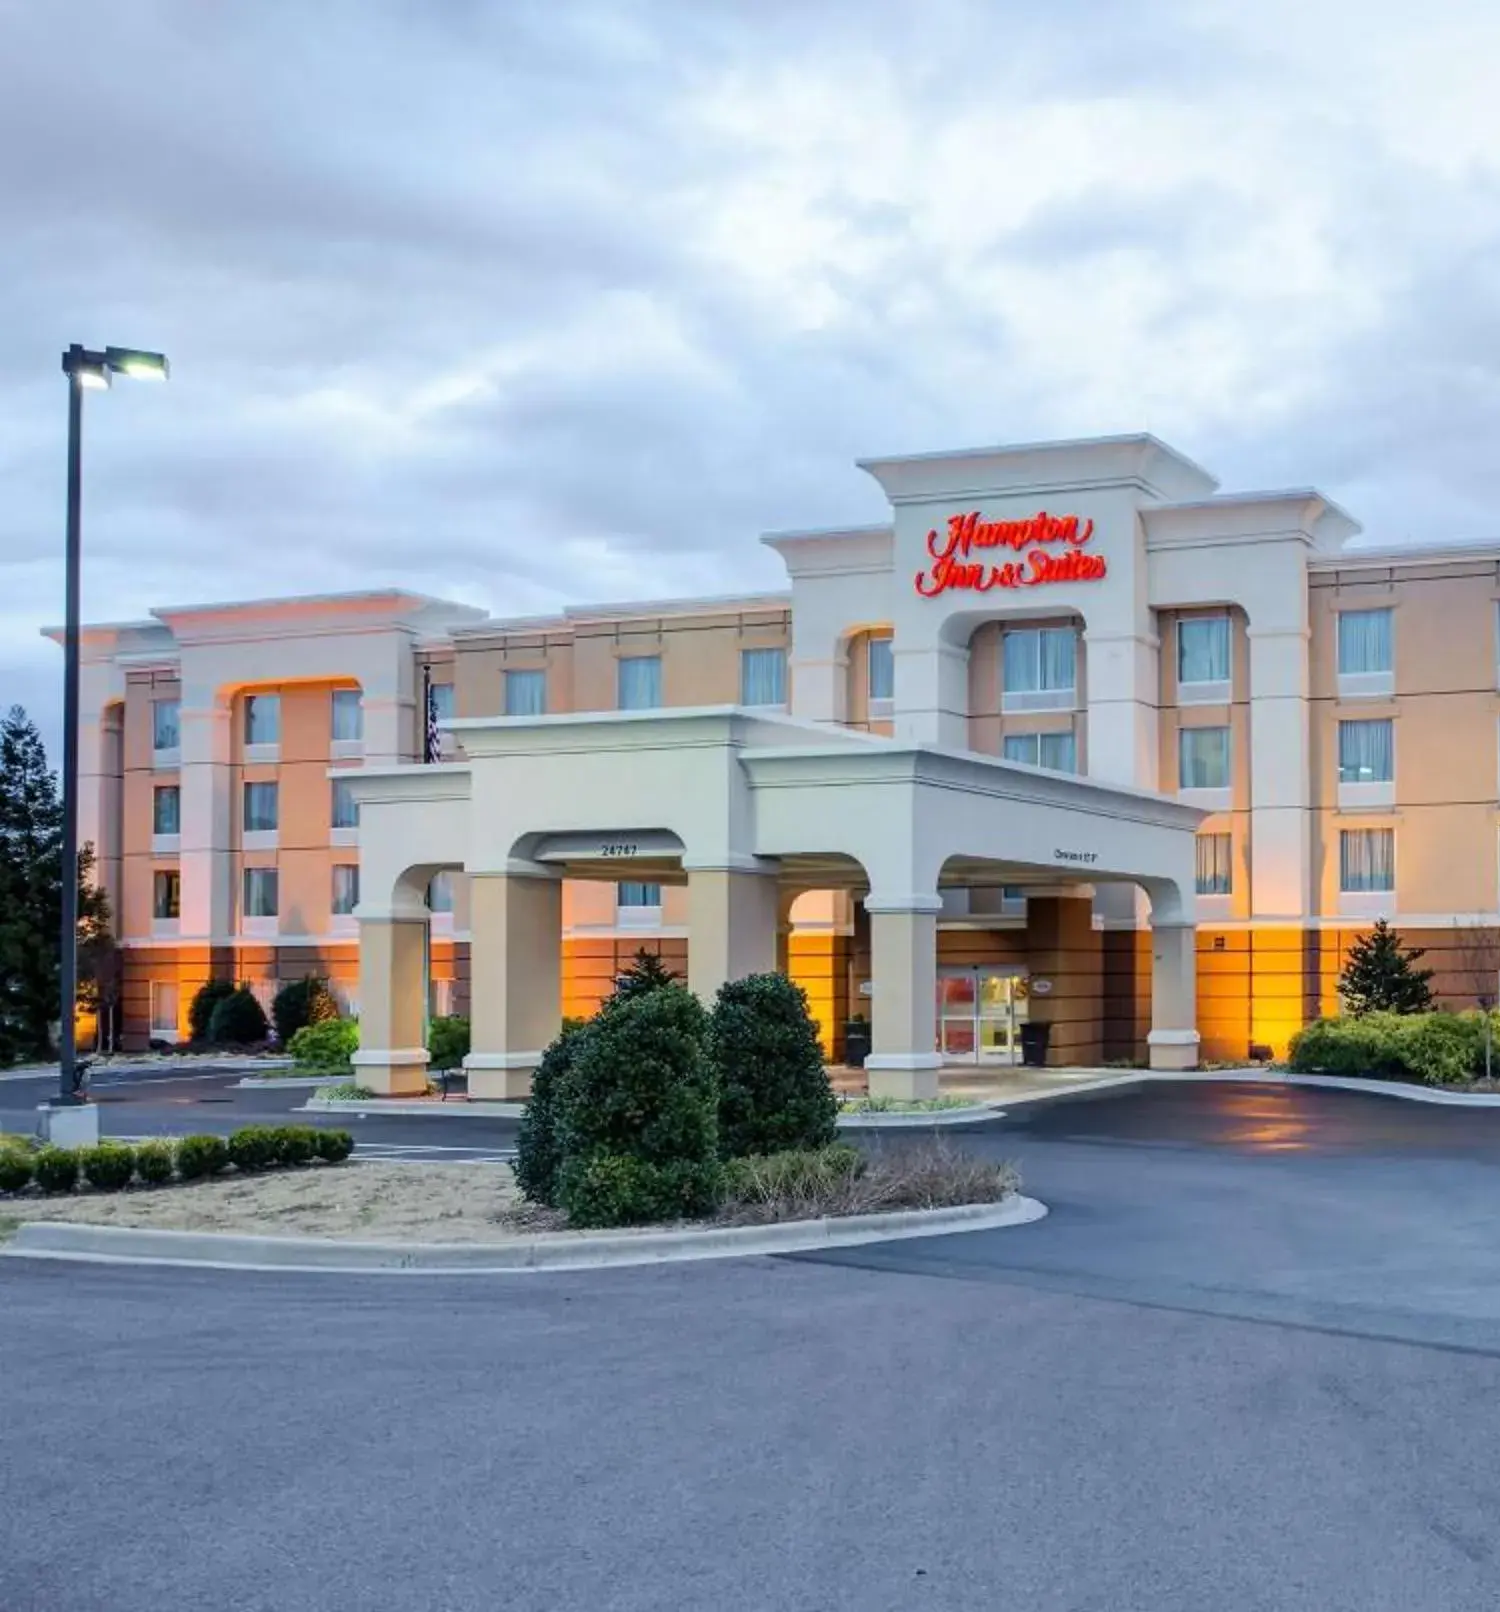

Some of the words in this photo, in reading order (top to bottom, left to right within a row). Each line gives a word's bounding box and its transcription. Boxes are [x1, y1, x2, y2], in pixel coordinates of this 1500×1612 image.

[927, 511, 1094, 558] Hampton
[914, 556, 999, 598] Inn
[1015, 549, 1107, 586] Suites
